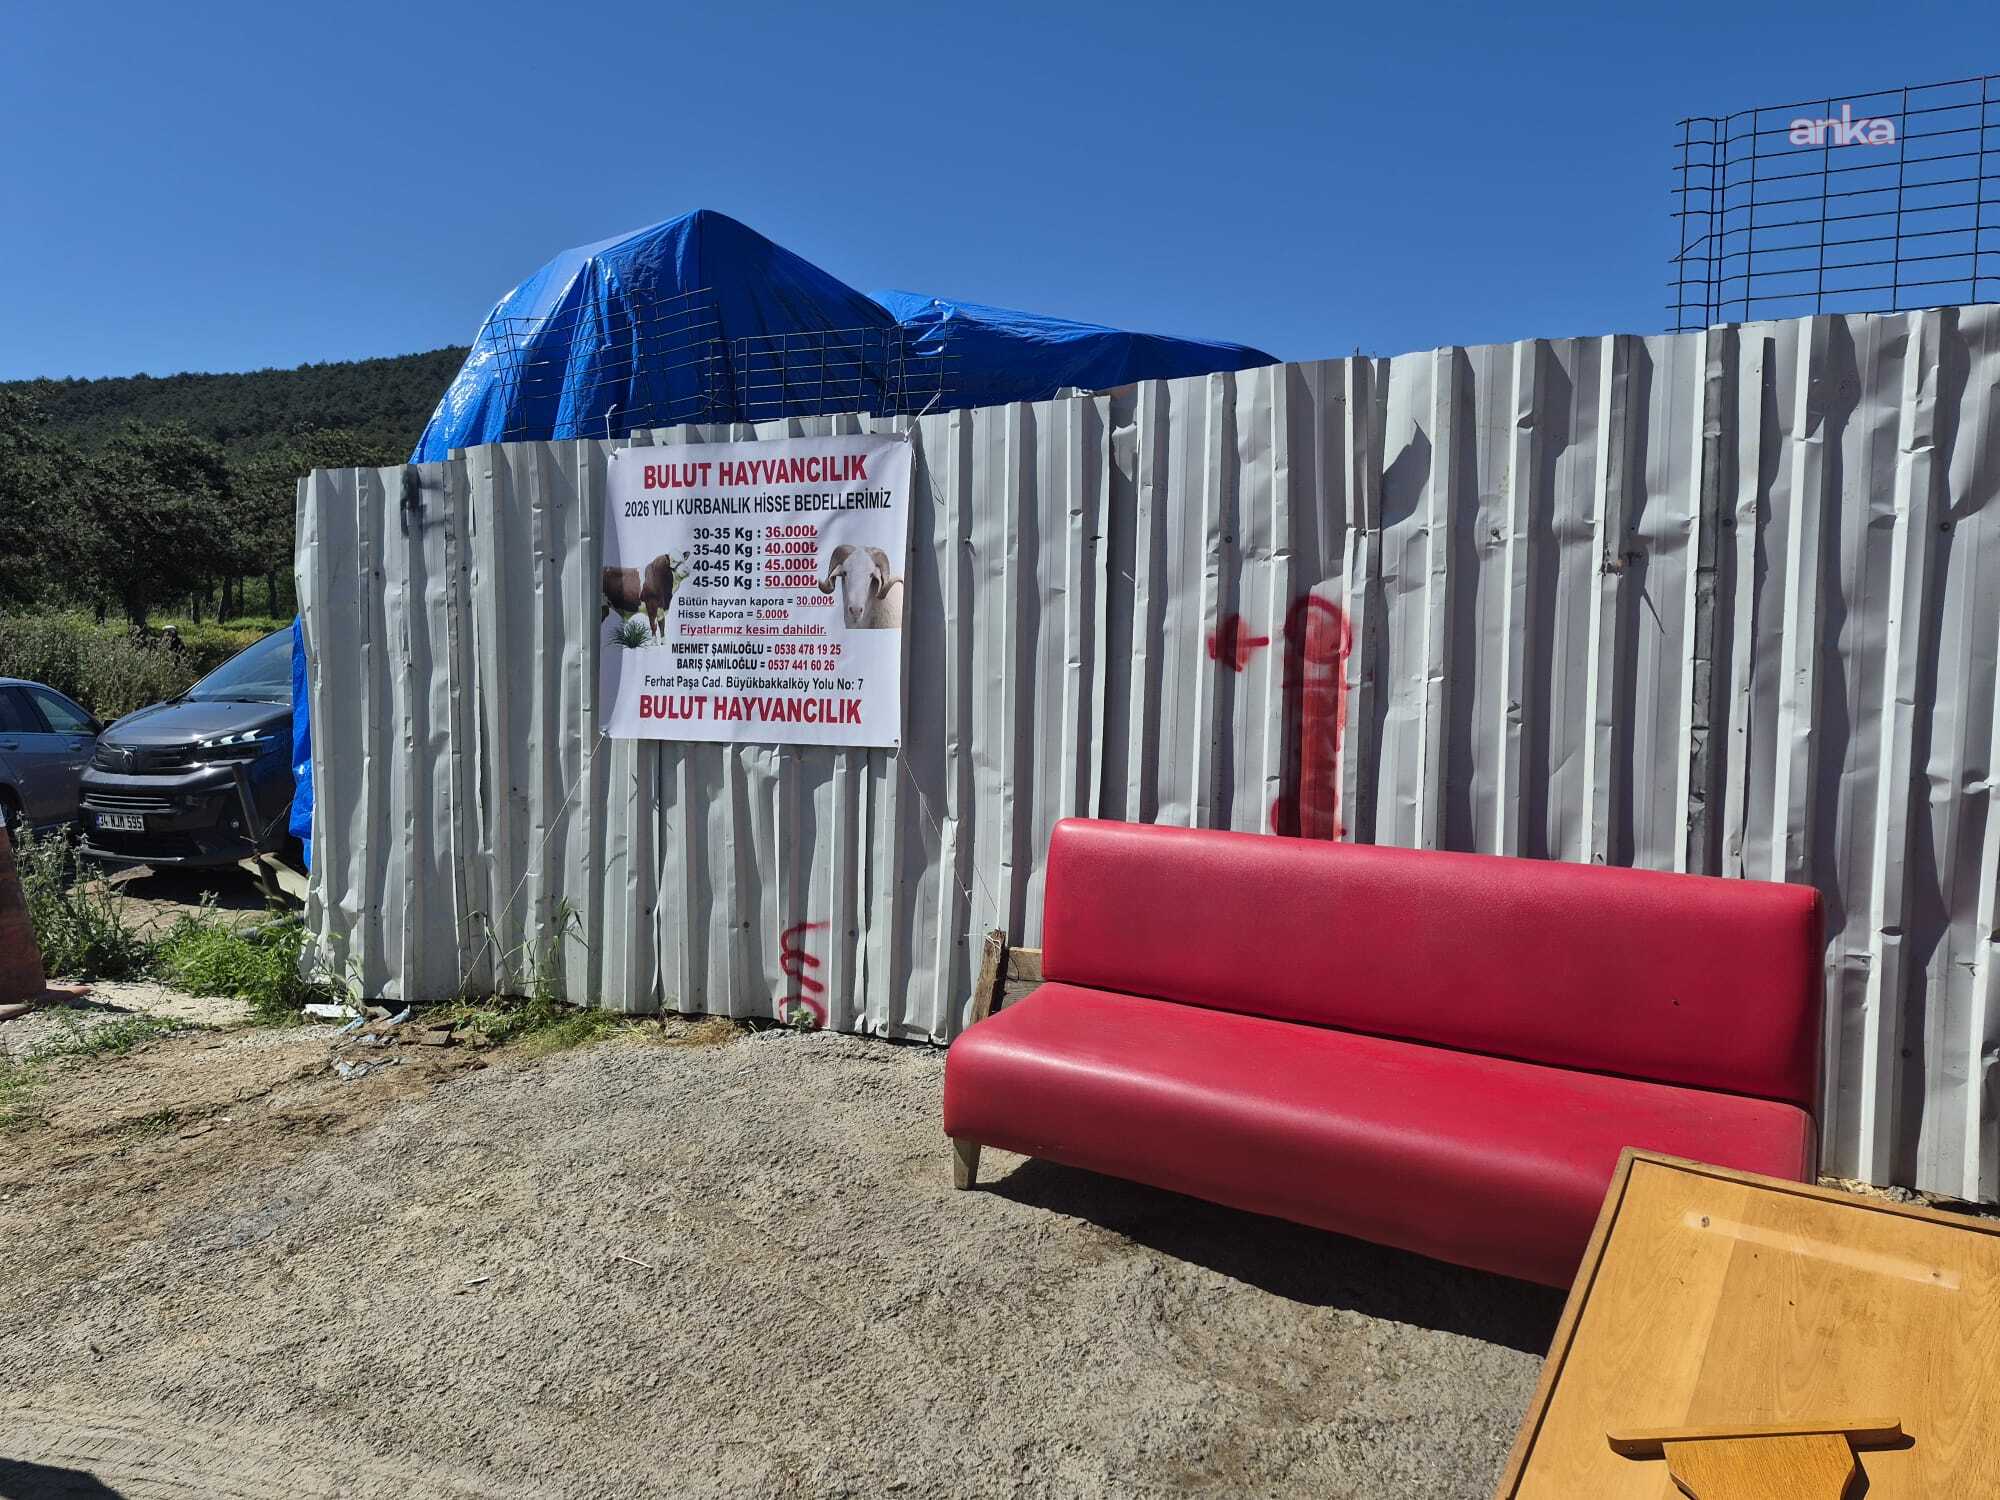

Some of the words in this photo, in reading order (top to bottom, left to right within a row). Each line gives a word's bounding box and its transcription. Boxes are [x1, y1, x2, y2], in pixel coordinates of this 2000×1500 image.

[643, 462, 712, 490] BULUT
[719, 454, 868, 487] HAYVANCILIK
[625, 501, 650, 517] 2026
[652, 499, 673, 516] YILI
[676, 497, 751, 515] KURBANLIK
[754, 491, 790, 513] HİSSE
[795, 487, 892, 512] BEDELLERİMİZ
[693, 527, 730, 539] 30-35
[735, 527, 753, 541] Kg
[693, 544, 730, 555] 35-40
[735, 543, 753, 557] Kg
[692, 559, 730, 571] 40-45
[734, 559, 752, 574] Kg
[692, 576, 730, 587] 45-50
[734, 575, 752, 590] Kg
[678, 597, 708, 606] Bütün
[711, 597, 747, 608] hayvan
[750, 597, 784, 608] kapora
[678, 610, 706, 619] Hisse
[708, 610, 744, 620] Kapora
[680, 624, 743, 636] Fiyatlarımız
[746, 624, 779, 635] kesim
[782, 624, 827, 635] dahildir.
[671, 643, 709, 654] MEHMET
[711, 641, 764, 656] ŞAMİLOĞLU
[774, 644, 796, 655] 0538
[798, 644, 814, 655] 478
[817, 644, 828, 655] 19
[830, 644, 841, 655] 25
[676, 658, 703, 672] BARIŞ
[705, 656, 757, 672] ŞAMİLOĞLU
[768, 659, 789, 671] 0537
[792, 660, 808, 671] 441
[811, 660, 822, 671] 60
[824, 660, 835, 671] 26
[645, 675, 674, 687] Ferhat
[677, 676, 699, 690] Paşa
[702, 676, 723, 688] Cad.
[726, 676, 810, 692] Büyükbakkalköy
[813, 677, 834, 690] Yolu
[837, 678, 854, 690] No:
[858, 678, 864, 690] 7
[640, 694, 707, 720] BULUT
[713, 696, 862, 724] HAYVANCILIK
[99, 815, 109, 827] 34
